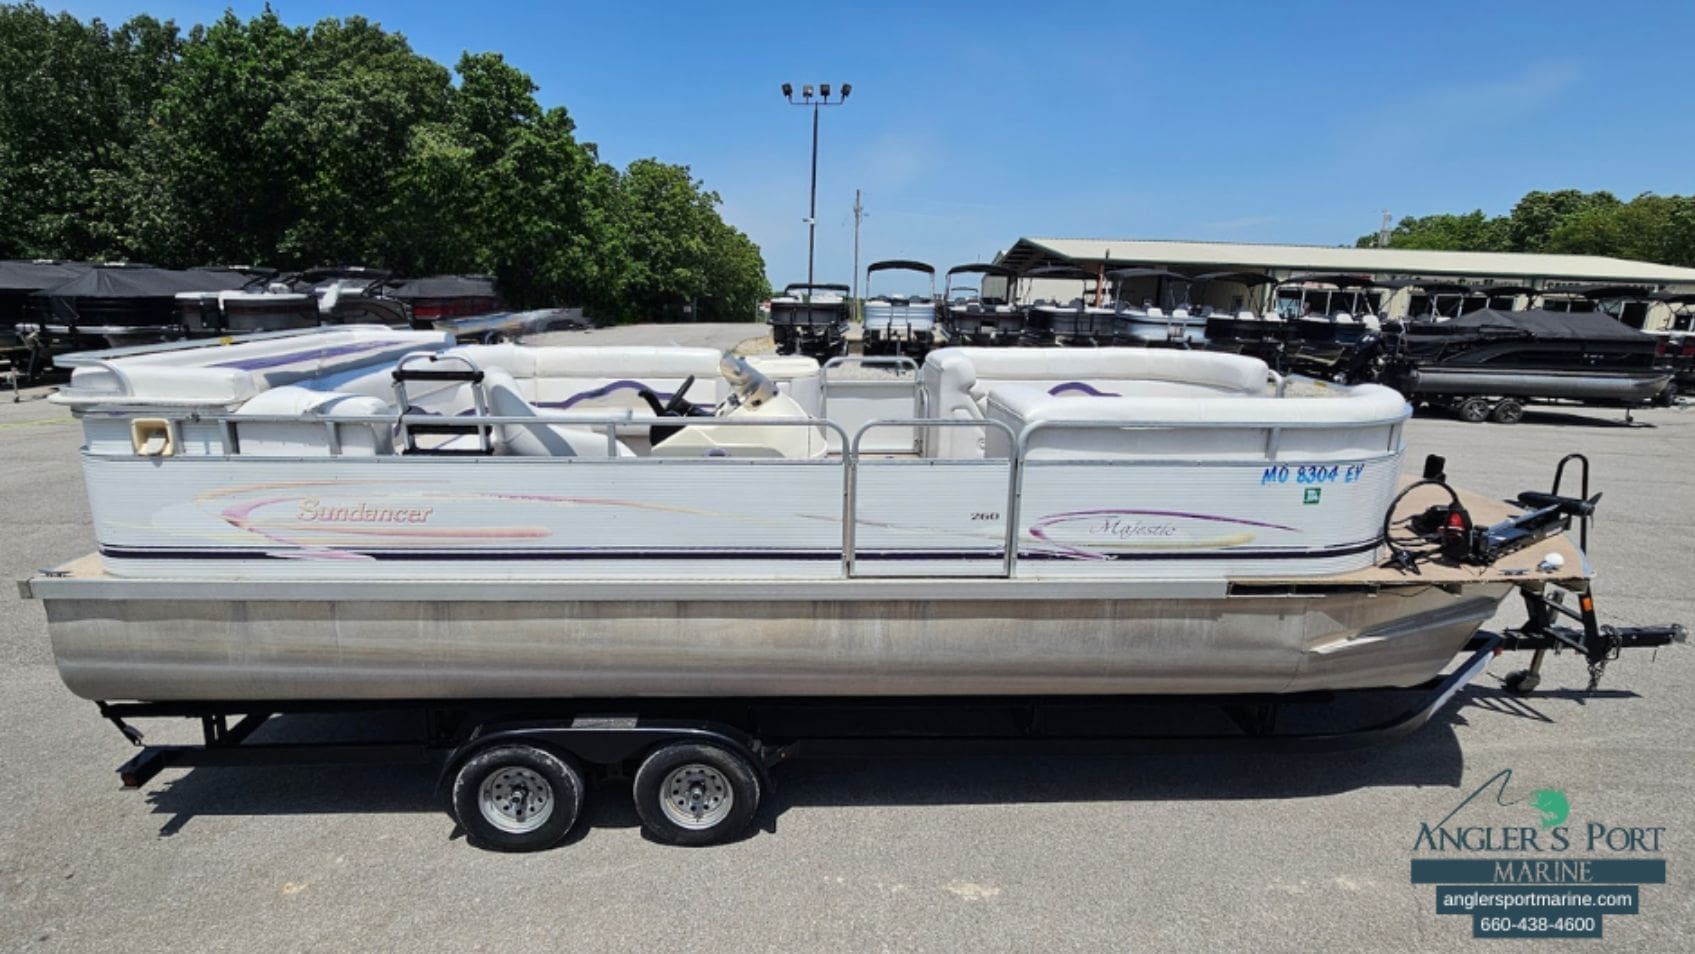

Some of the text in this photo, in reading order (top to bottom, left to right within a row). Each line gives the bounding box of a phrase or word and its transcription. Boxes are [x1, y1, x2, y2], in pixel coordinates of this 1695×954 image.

[1261, 463, 1290, 485] MO
[1297, 464, 1338, 483] 8304
[296, 495, 433, 523] Sundancer
[970, 511, 1000, 521] 260
[1089, 516, 1177, 540] Majestic
